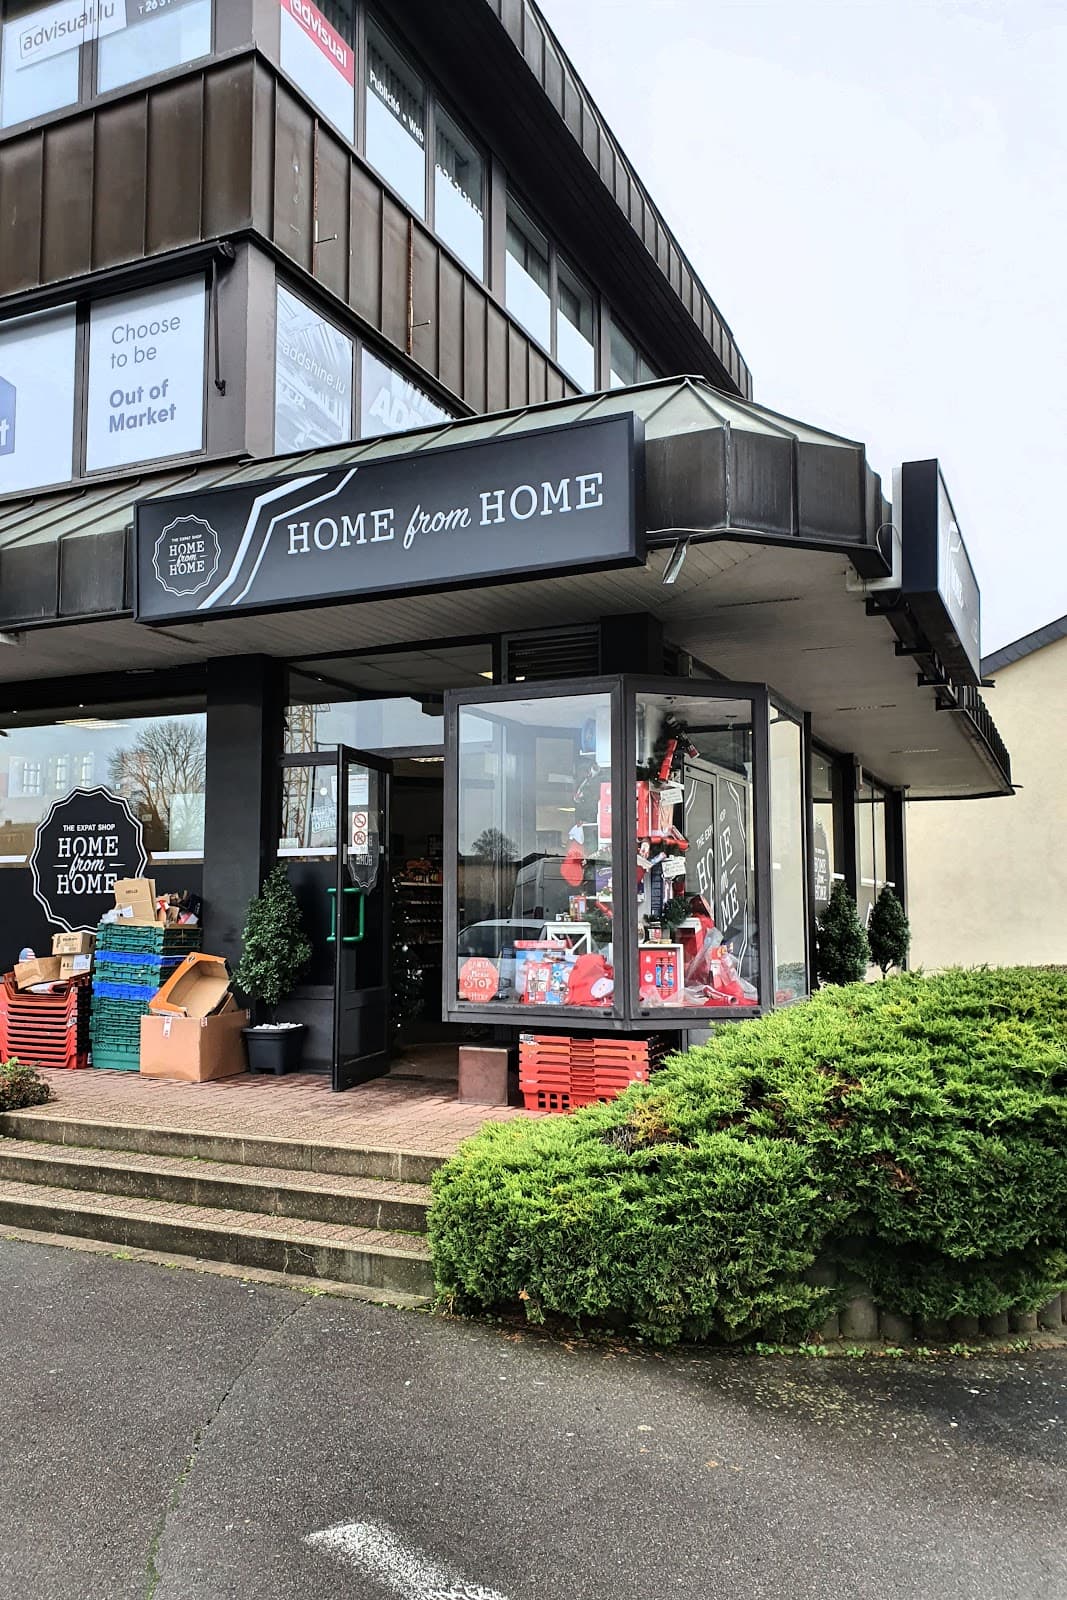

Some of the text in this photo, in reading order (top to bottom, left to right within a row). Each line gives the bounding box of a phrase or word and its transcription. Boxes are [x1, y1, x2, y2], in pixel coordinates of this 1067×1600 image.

[23, 2, 114, 51] advisual.lu
[292, 0, 347, 68] advisual
[370, 69, 424, 142] Publicité Web
[111, 316, 181, 344] Choose
[111, 346, 157, 369] to be
[283, 342, 346, 395] addshine.lu
[109, 378, 169, 408] Out of
[109, 403, 177, 433] Market
[287, 472, 603, 555] HOME from HOME
[169, 541, 205, 556] HOME
[176, 553, 198, 568] from
[169, 560, 205, 576] HOME
[63, 823, 116, 832] THE EXPAT SHOP
[57, 835, 119, 858] HOME
[68, 852, 106, 880] from
[56, 873, 118, 895] HOME
[463, 975, 493, 989] STOP
